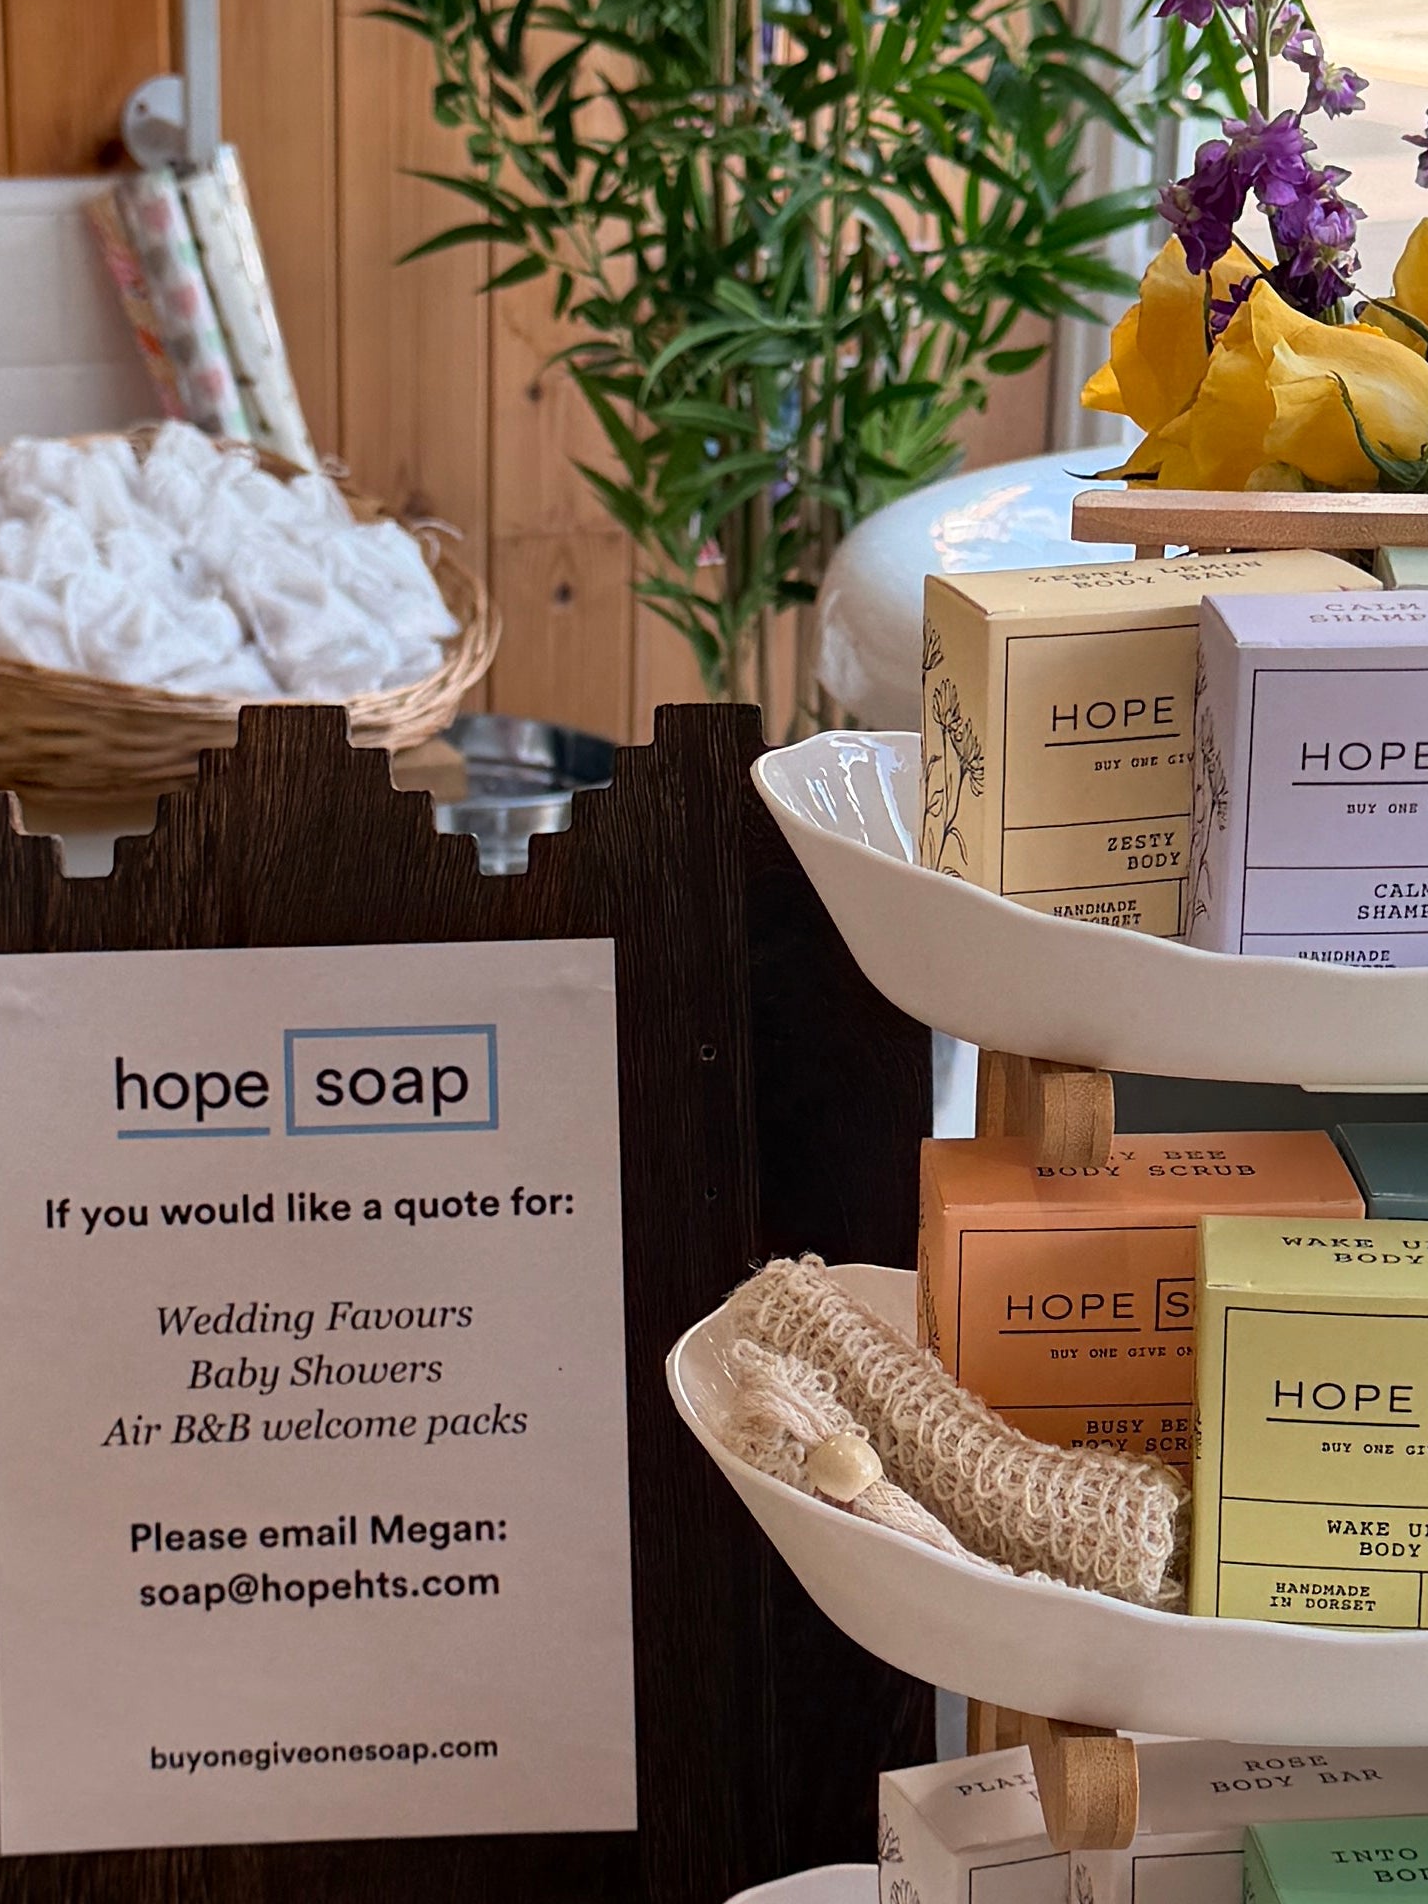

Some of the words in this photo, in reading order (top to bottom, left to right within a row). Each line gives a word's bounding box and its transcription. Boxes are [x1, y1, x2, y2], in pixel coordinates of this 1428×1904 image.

[1028, 568, 1133, 584] ZESTY
[1159, 560, 1264, 575] LEMON
[1072, 575, 1157, 589] BODY
[1184, 569, 1246, 582] BAR
[1325, 601, 1421, 612] CALM
[1051, 696, 1175, 732] HOPE
[1347, 803, 1377, 814] BUY
[1388, 802, 1418, 814] ONE
[114, 1056, 271, 1122] hope
[314, 1059, 470, 1116] soap
[1036, 1166, 1120, 1177] BODY
[1148, 1165, 1257, 1177] SCRUB
[44, 1197, 72, 1230] If
[81, 1203, 149, 1236] you
[160, 1194, 275, 1227] would
[286, 1191, 352, 1224] like
[362, 1198, 383, 1221] a
[393, 1190, 502, 1228] quote
[511, 1186, 575, 1218] for:
[1281, 1237, 1374, 1248] WAKE
[1334, 1252, 1423, 1265] BODY
[1006, 1293, 1135, 1321] HOPE
[156, 1305, 316, 1341] Wedding
[325, 1301, 473, 1333] Favours
[187, 1358, 281, 1395] Baby
[289, 1354, 444, 1389] Showers
[1274, 1380, 1414, 1414] HOPE
[101, 1416, 162, 1448] Air
[171, 1413, 252, 1446] B&B
[262, 1409, 418, 1442] welcome
[425, 1405, 530, 1443] packs
[1086, 1420, 1144, 1434] BUSY
[1321, 1441, 1352, 1453] BUY
[1363, 1443, 1394, 1455] ONE
[129, 1520, 249, 1554] Please
[259, 1518, 358, 1550] email
[369, 1515, 509, 1552] Megan:
[1327, 1520, 1390, 1537] WAKE
[1359, 1542, 1421, 1558] BODY
[139, 1567, 502, 1608] soap@hopehts.com
[1275, 1582, 1371, 1597] HANDMADE
[1269, 1597, 1292, 1608] IN
[1305, 1598, 1377, 1612] DORSET
[149, 1736, 499, 1773] buyonegiveonesoap.com
[1244, 1755, 1328, 1772] ROSE
[1211, 1776, 1293, 1794] BODY
[1318, 1768, 1383, 1786] BAR
[1331, 1847, 1418, 1863] INTO
